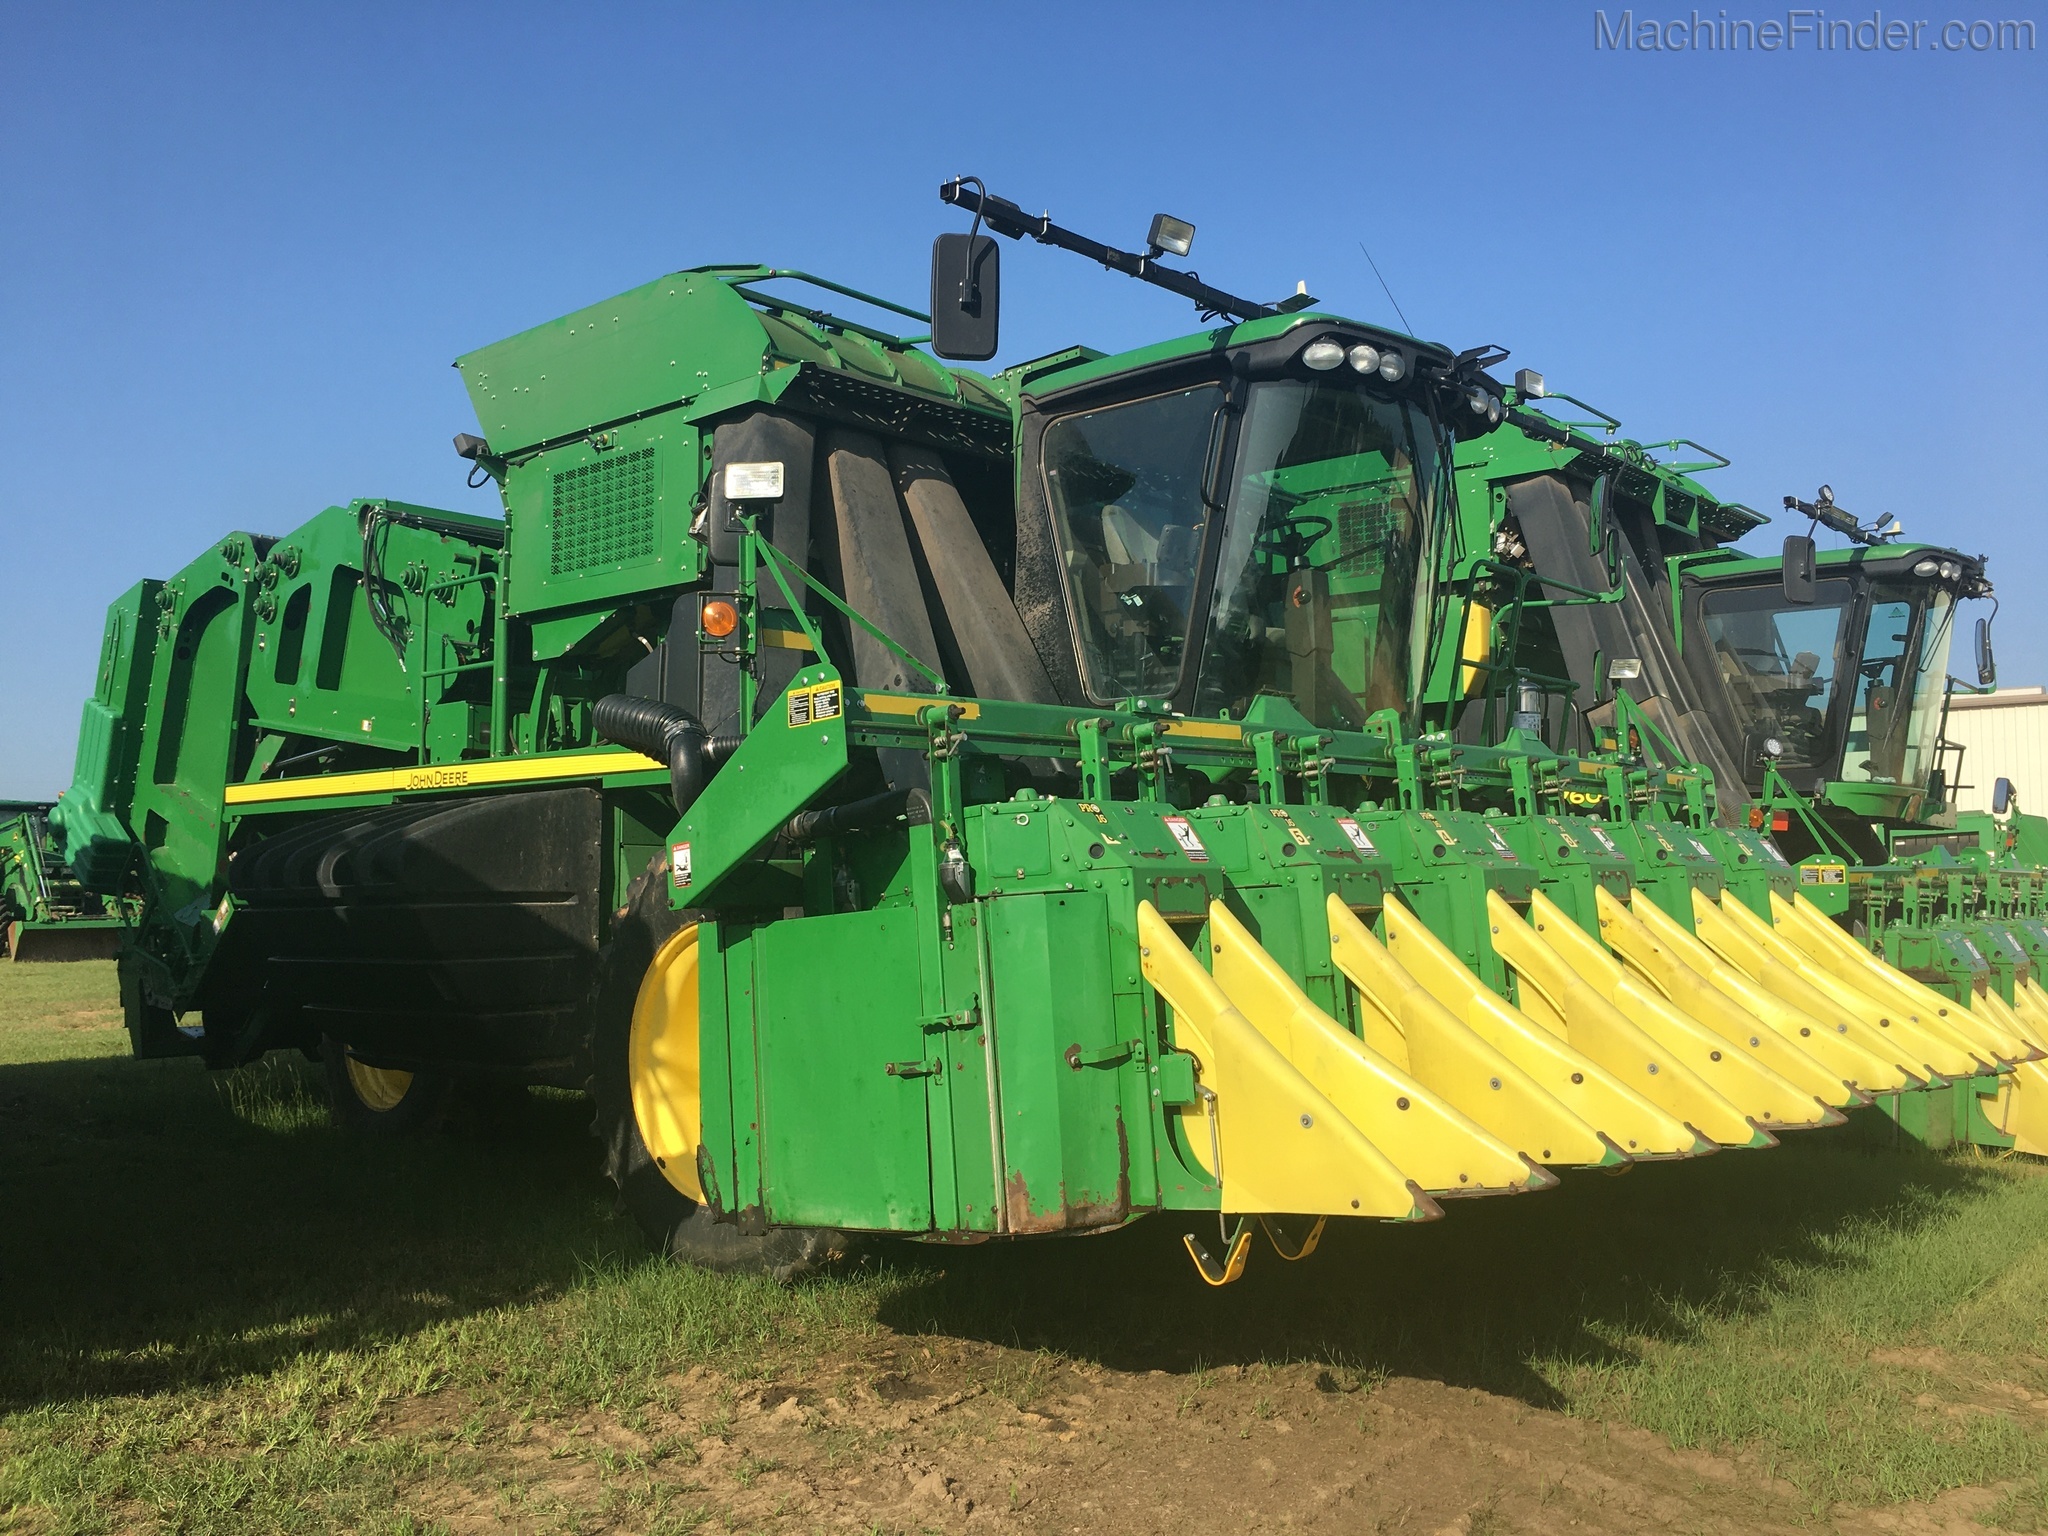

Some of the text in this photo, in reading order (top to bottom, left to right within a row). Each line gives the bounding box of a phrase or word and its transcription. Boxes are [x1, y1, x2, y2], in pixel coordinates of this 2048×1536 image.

[406, 770, 468, 788] JOHN DEERE
[1293, 830, 1305, 843] 5
